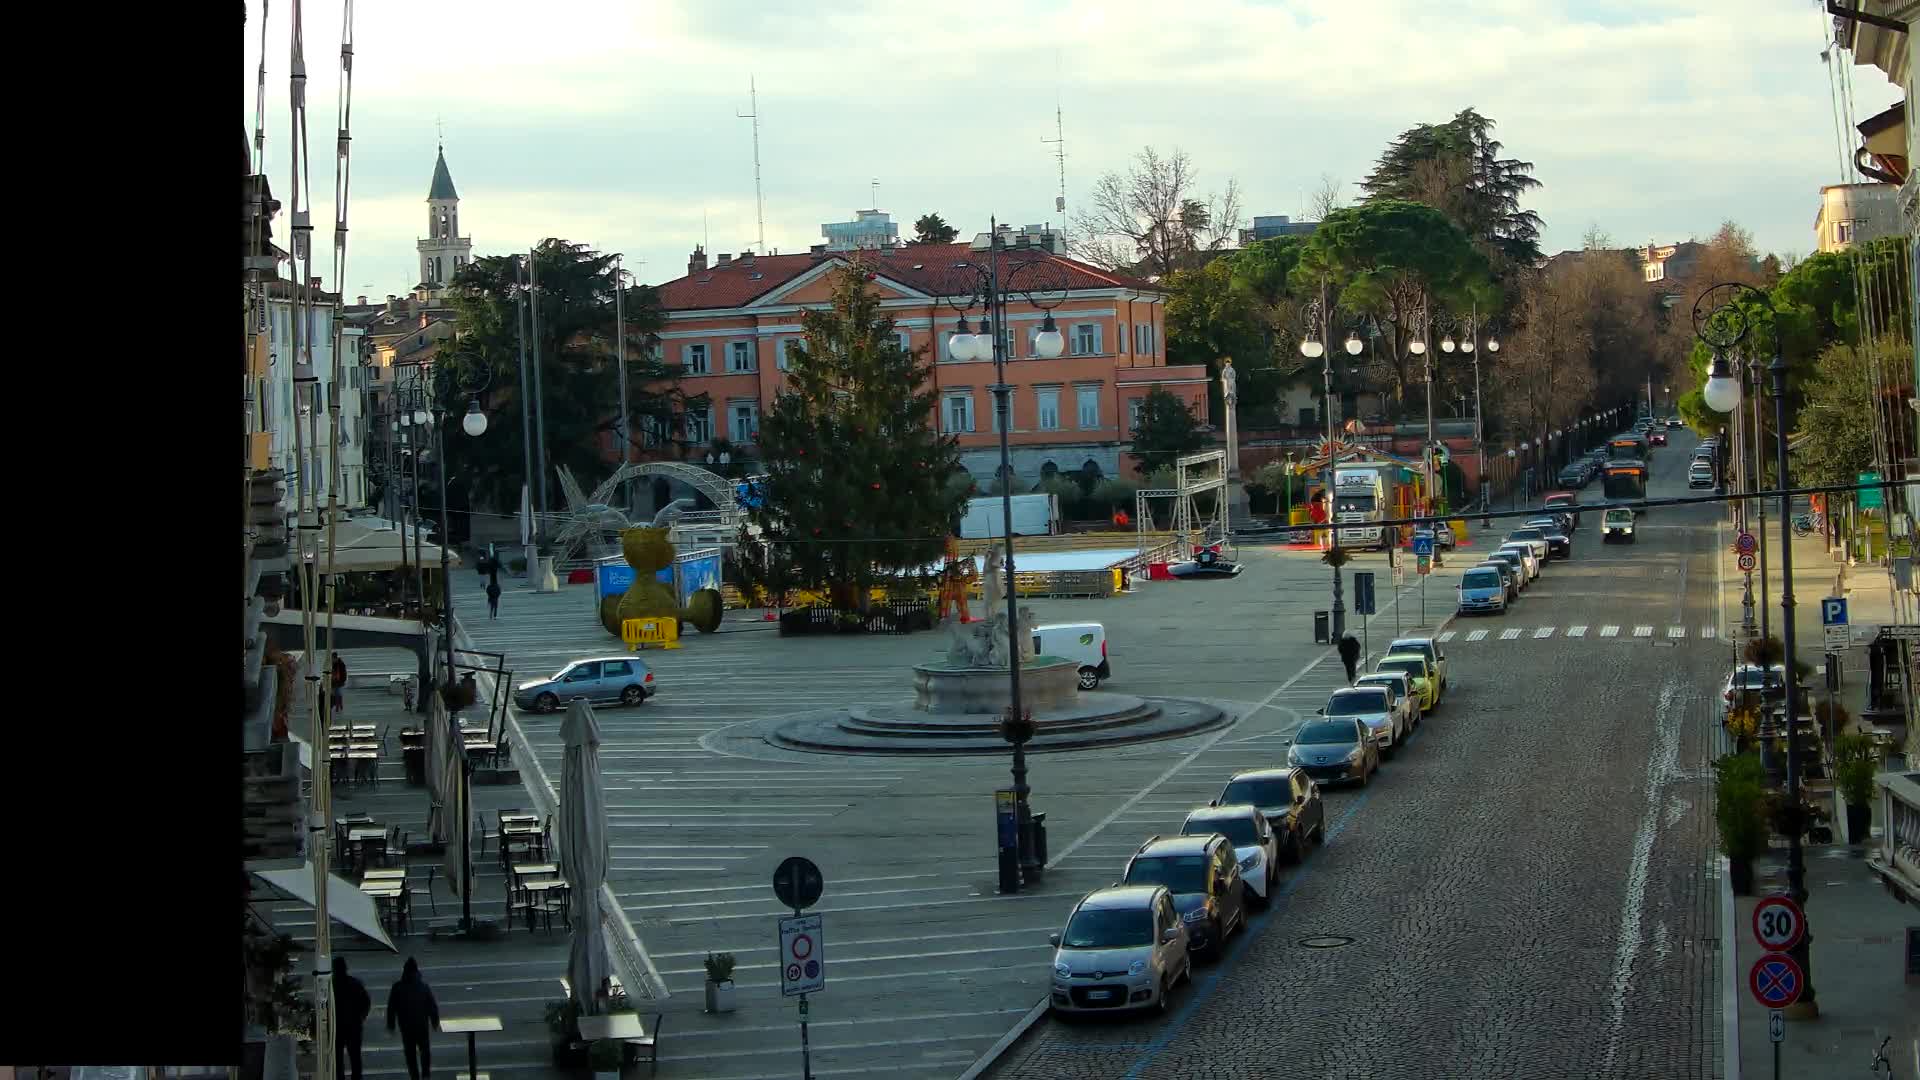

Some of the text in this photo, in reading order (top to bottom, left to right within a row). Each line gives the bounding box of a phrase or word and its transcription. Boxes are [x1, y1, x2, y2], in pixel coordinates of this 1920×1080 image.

[1742, 557, 1753, 567] 20
[1827, 602, 1842, 622] P
[1762, 910, 1792, 938] 30
